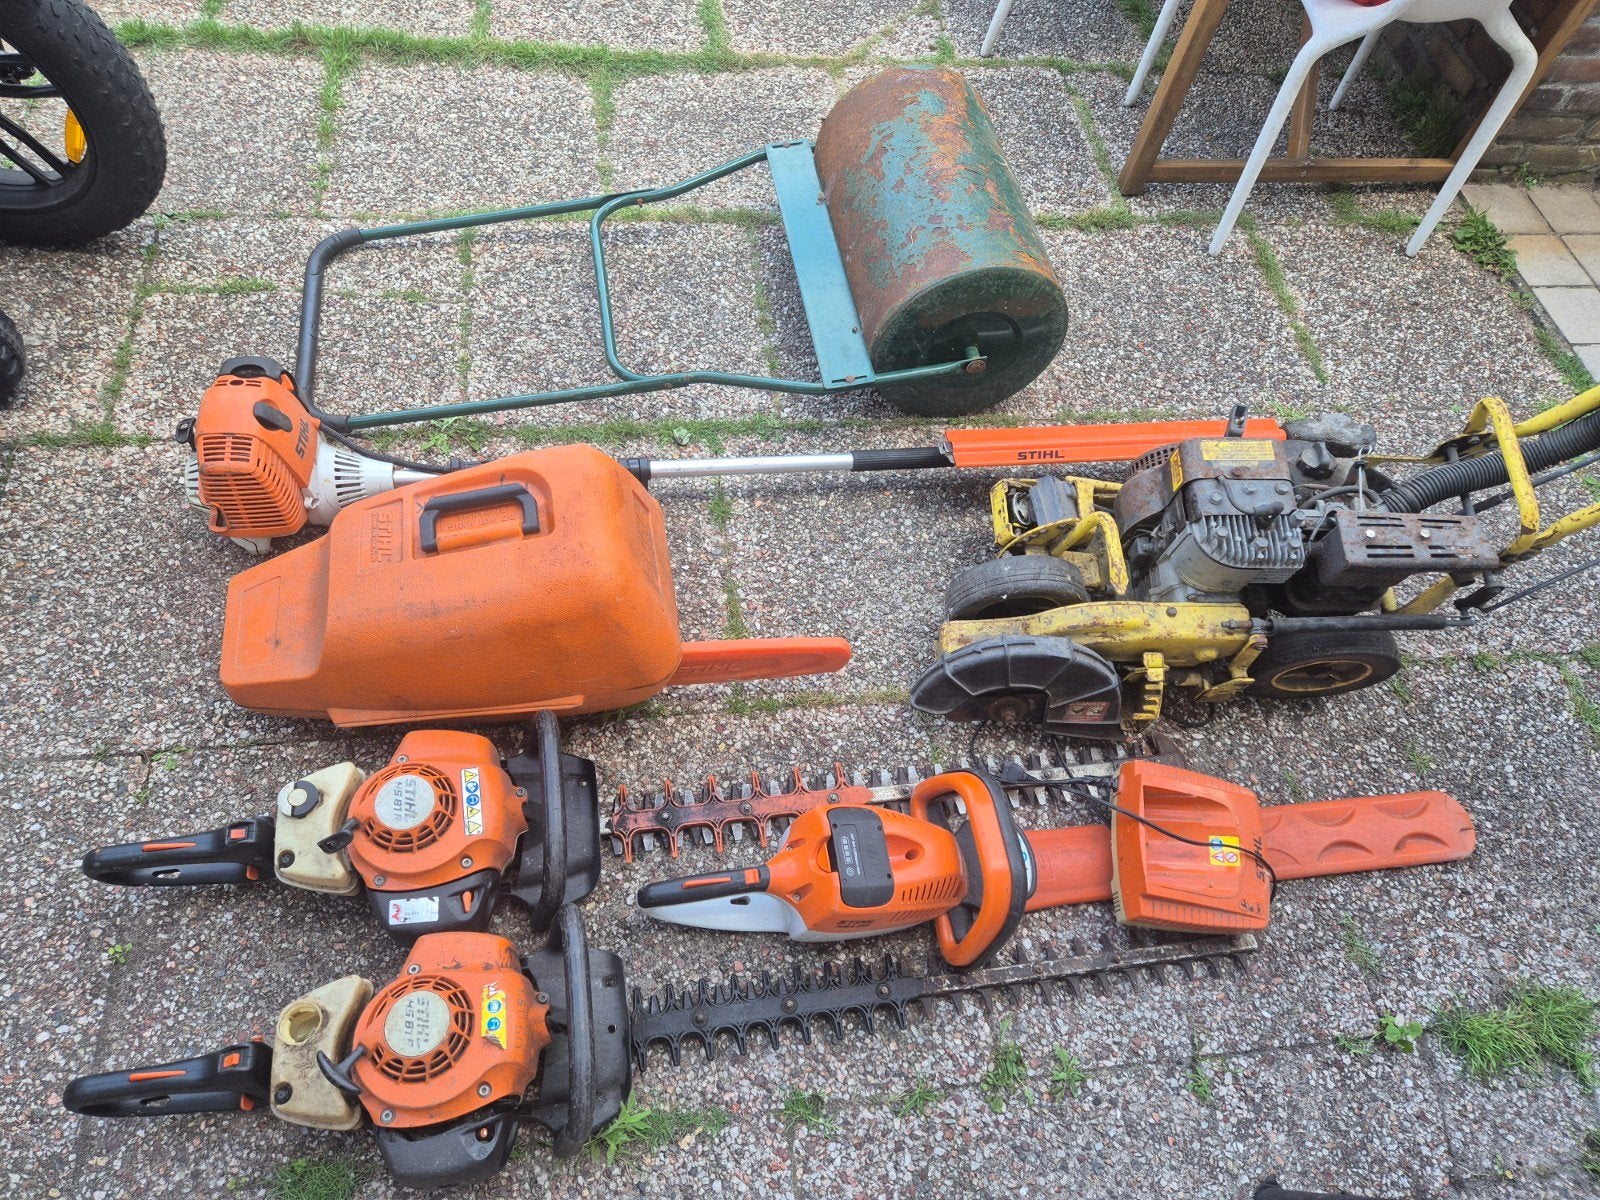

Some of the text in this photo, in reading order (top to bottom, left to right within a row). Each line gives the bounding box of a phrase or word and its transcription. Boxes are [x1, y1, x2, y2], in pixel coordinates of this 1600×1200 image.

[294, 418, 309, 460] STIHL
[1017, 450, 1065, 460] STIHL
[377, 512, 392, 563] STIHL
[404, 777, 418, 821] STIHL
